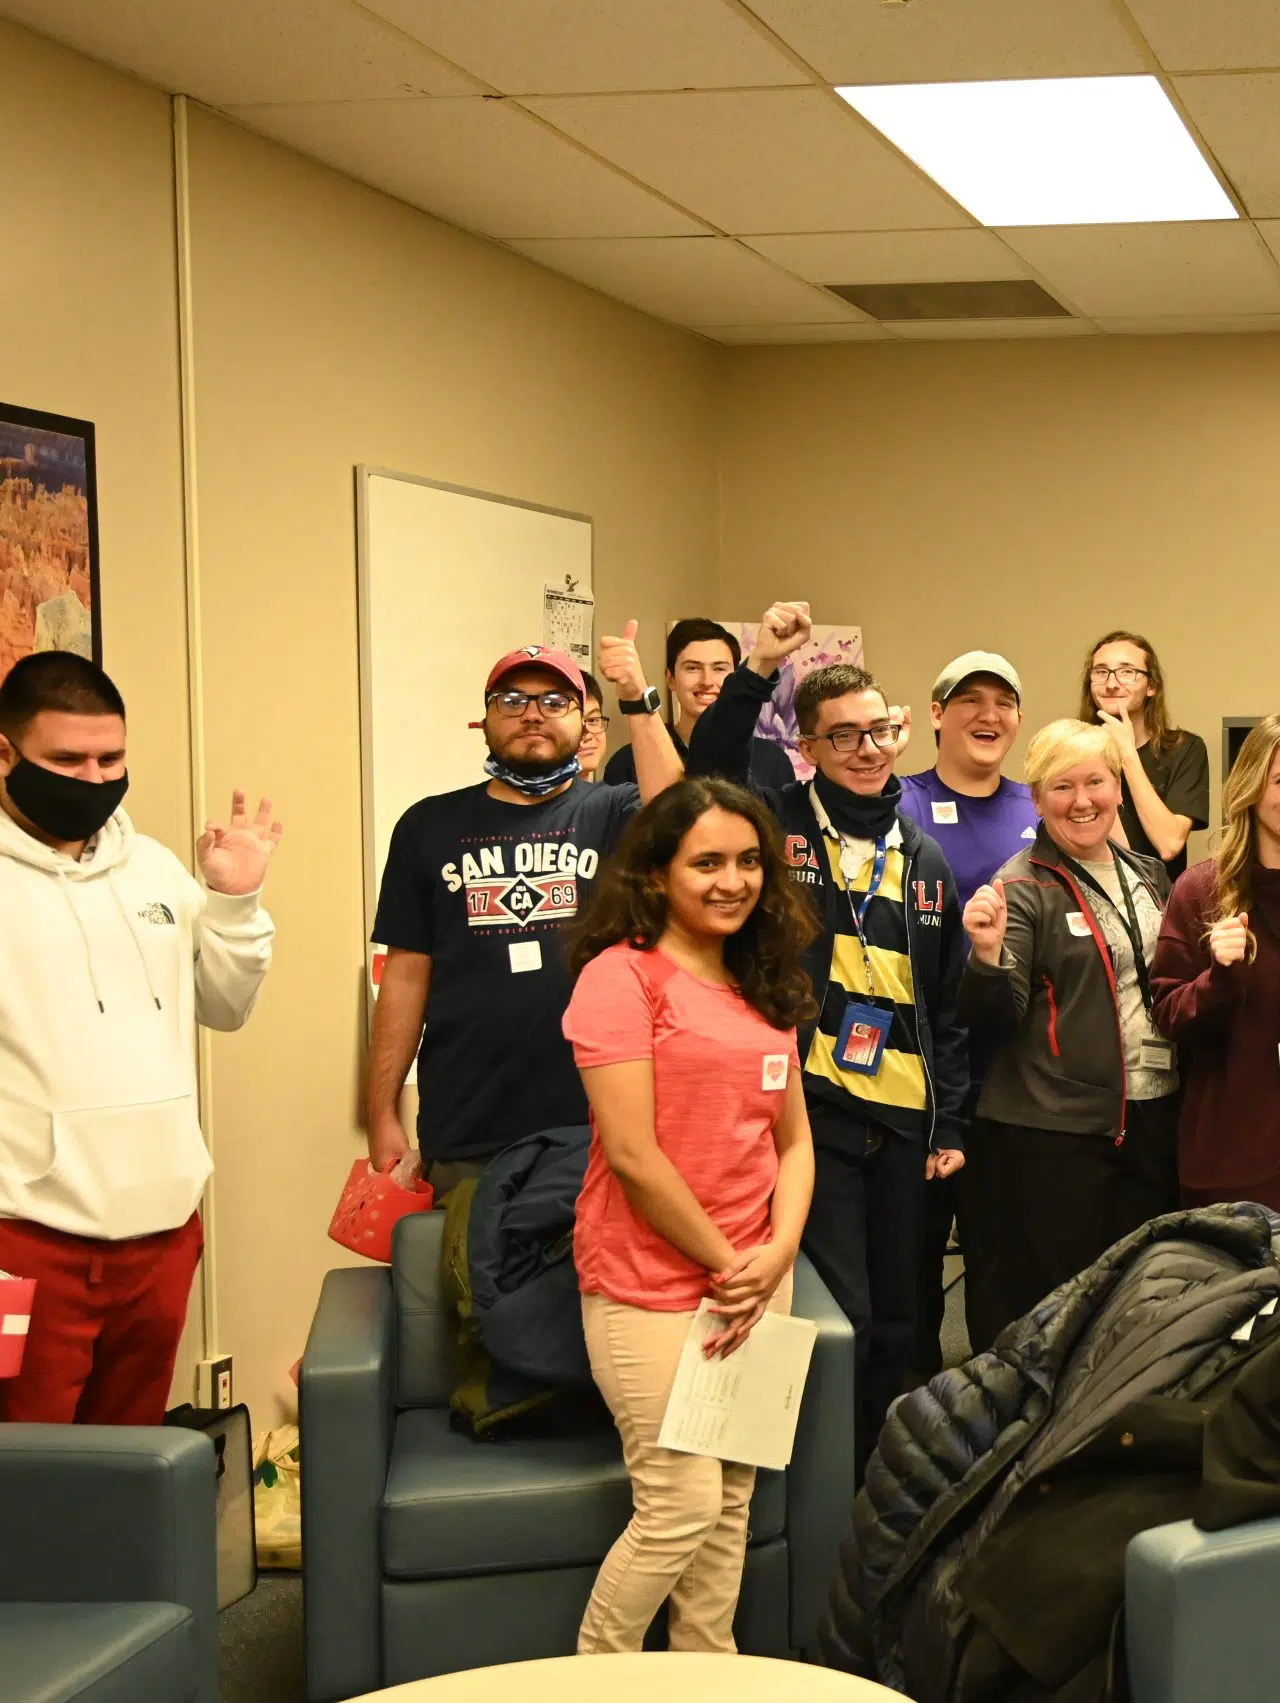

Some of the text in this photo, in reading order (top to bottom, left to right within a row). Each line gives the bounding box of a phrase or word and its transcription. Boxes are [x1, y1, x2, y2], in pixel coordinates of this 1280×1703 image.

[441, 842, 599, 893] SAN DIEGO
[467, 884, 575, 913] 17 69
[510, 892, 534, 911] CA
